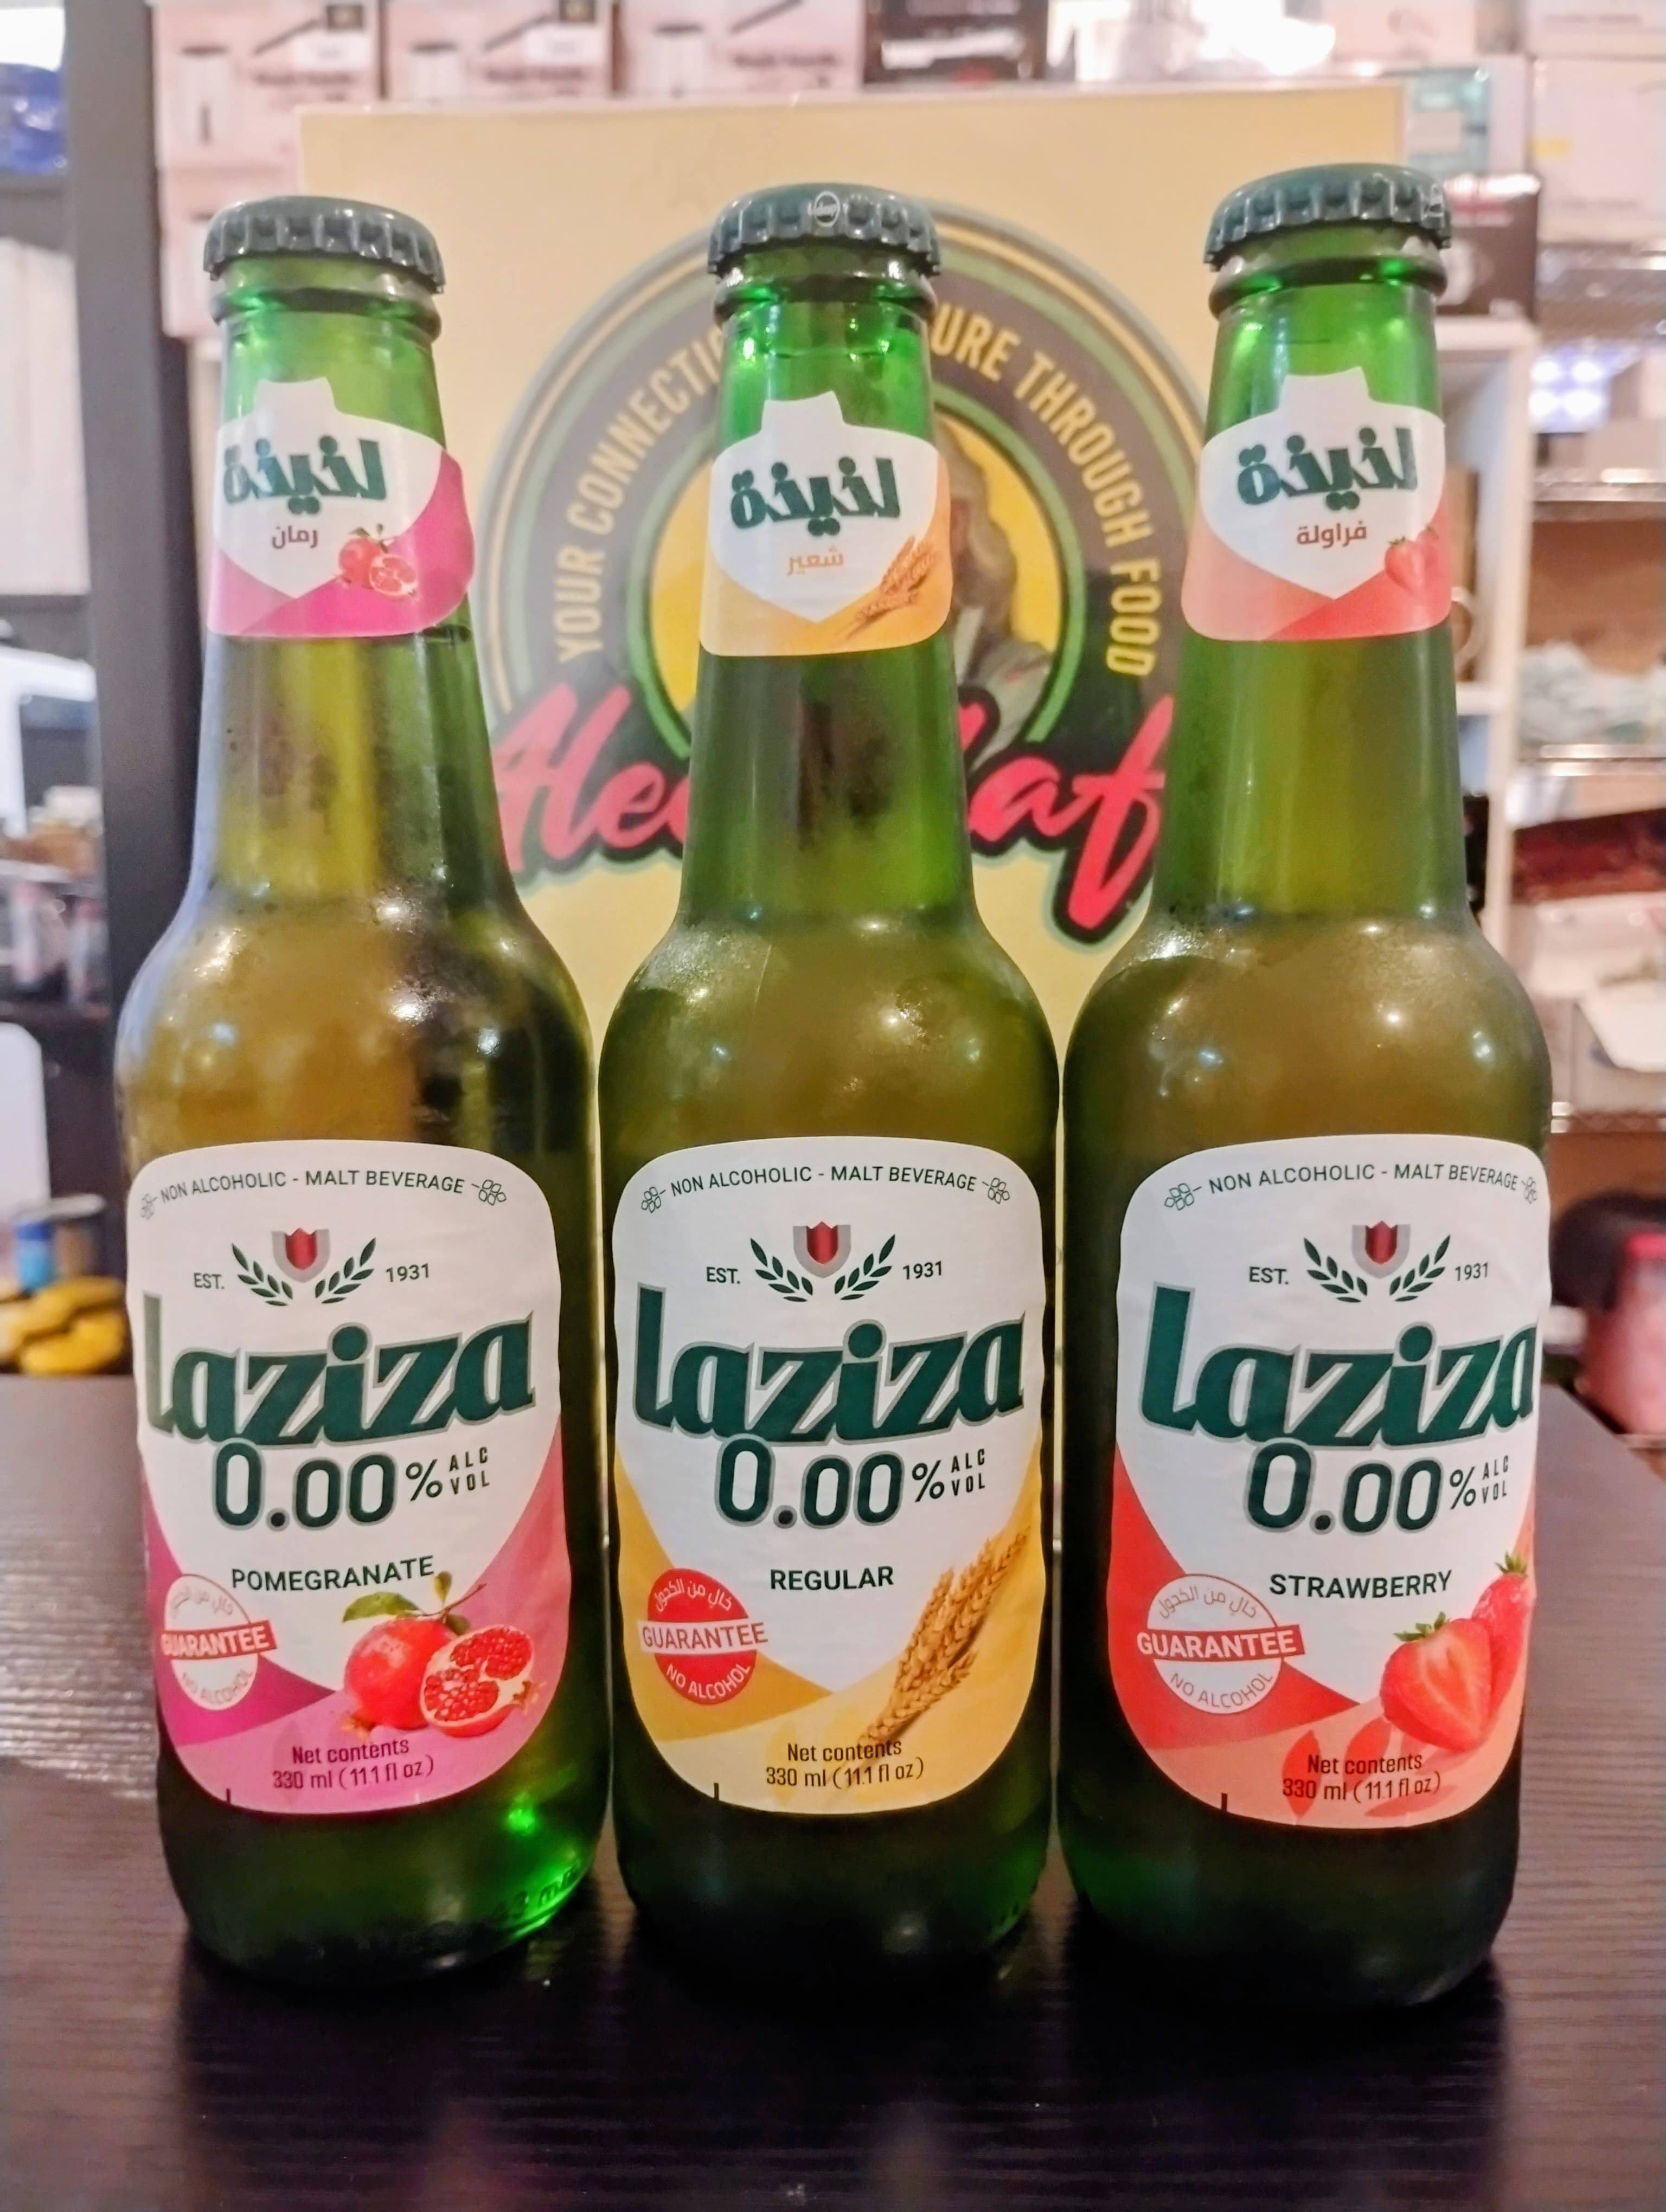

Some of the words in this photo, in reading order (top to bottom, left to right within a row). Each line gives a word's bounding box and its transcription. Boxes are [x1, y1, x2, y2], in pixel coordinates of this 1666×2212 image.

[565, 326, 723, 537] CONNECTI
[1013, 349, 1155, 549] THROUGH
[271, 525, 319, 550] رمان
[1296, 520, 1368, 549] فراولة
[787, 545, 844, 576] شعير
[553, 544, 605, 664] YOUR
[1105, 557, 1164, 678] FOOD
[160, 1182, 188, 1204] NON
[191, 1171, 287, 1195] ALCOHOLIC
[305, 1169, 360, 1186] MALT
[366, 1170, 465, 1194] BEVERAGE
[670, 1175, 704, 1197] NON
[708, 1166, 812, 1189] ALCOHOLIC
[830, 1165, 884, 1182] MALT
[889, 1166, 977, 1192] BEVERAGE
[1208, 1172, 1253, 1195] NON
[1258, 1163, 1375, 1187] ALCOHOLIC
[1394, 1163, 1444, 1181] MALT
[1448, 1165, 1518, 1191] BEVERAGE
[193, 1271, 226, 1290] EST.
[385, 1262, 431, 1284] 1931
[706, 1266, 741, 1285] EST.
[902, 1260, 943, 1281] 1931
[1248, 1266, 1290, 1285] EST.
[1454, 1262, 1489, 1282] 1931
[448, 1446, 489, 1472] ALC
[951, 1448, 986, 1474] ALC
[1481, 1455, 1510, 1482] ALC
[450, 1473, 490, 1495] VOL
[951, 1476, 986, 1497] VOL
[1481, 1482, 1508, 1504] VOL
[231, 1555, 434, 1592] POMEGRANATE
[770, 1565, 895, 1591] REGULAR
[1268, 1570, 1453, 1599] STRAWBERRY
[654, 1577, 687, 1612] الكحول
[687, 1580, 706, 1599] من
[642, 1622, 769, 1649] GUARANTEE
[1136, 1629, 1297, 1659] GUARANTEE
[665, 1663, 686, 1688] NO
[688, 1663, 751, 1700] ALCOHOL
[1170, 1672, 1195, 1697] NO
[1197, 1673, 1274, 1708] ALCOHOL
[292, 1745, 321, 1764] Net
[327, 1738, 411, 1763] contents
[787, 1742, 817, 1761] Net
[823, 1739, 902, 1761] contents
[272, 1770, 304, 1789] 330
[310, 1773, 333, 1789] ml
[386, 1763, 398, 1782] fl
[766, 1767, 797, 1786] 330
[804, 1769, 826, 1787] ml
[878, 1763, 890, 1783] fl
[1308, 1754, 1340, 1773] Net
[1344, 1754, 1422, 1774] contents
[1282, 1778, 1317, 1799] 330
[1323, 1782, 1346, 1801] ml
[1399, 1778, 1409, 1797] fl
